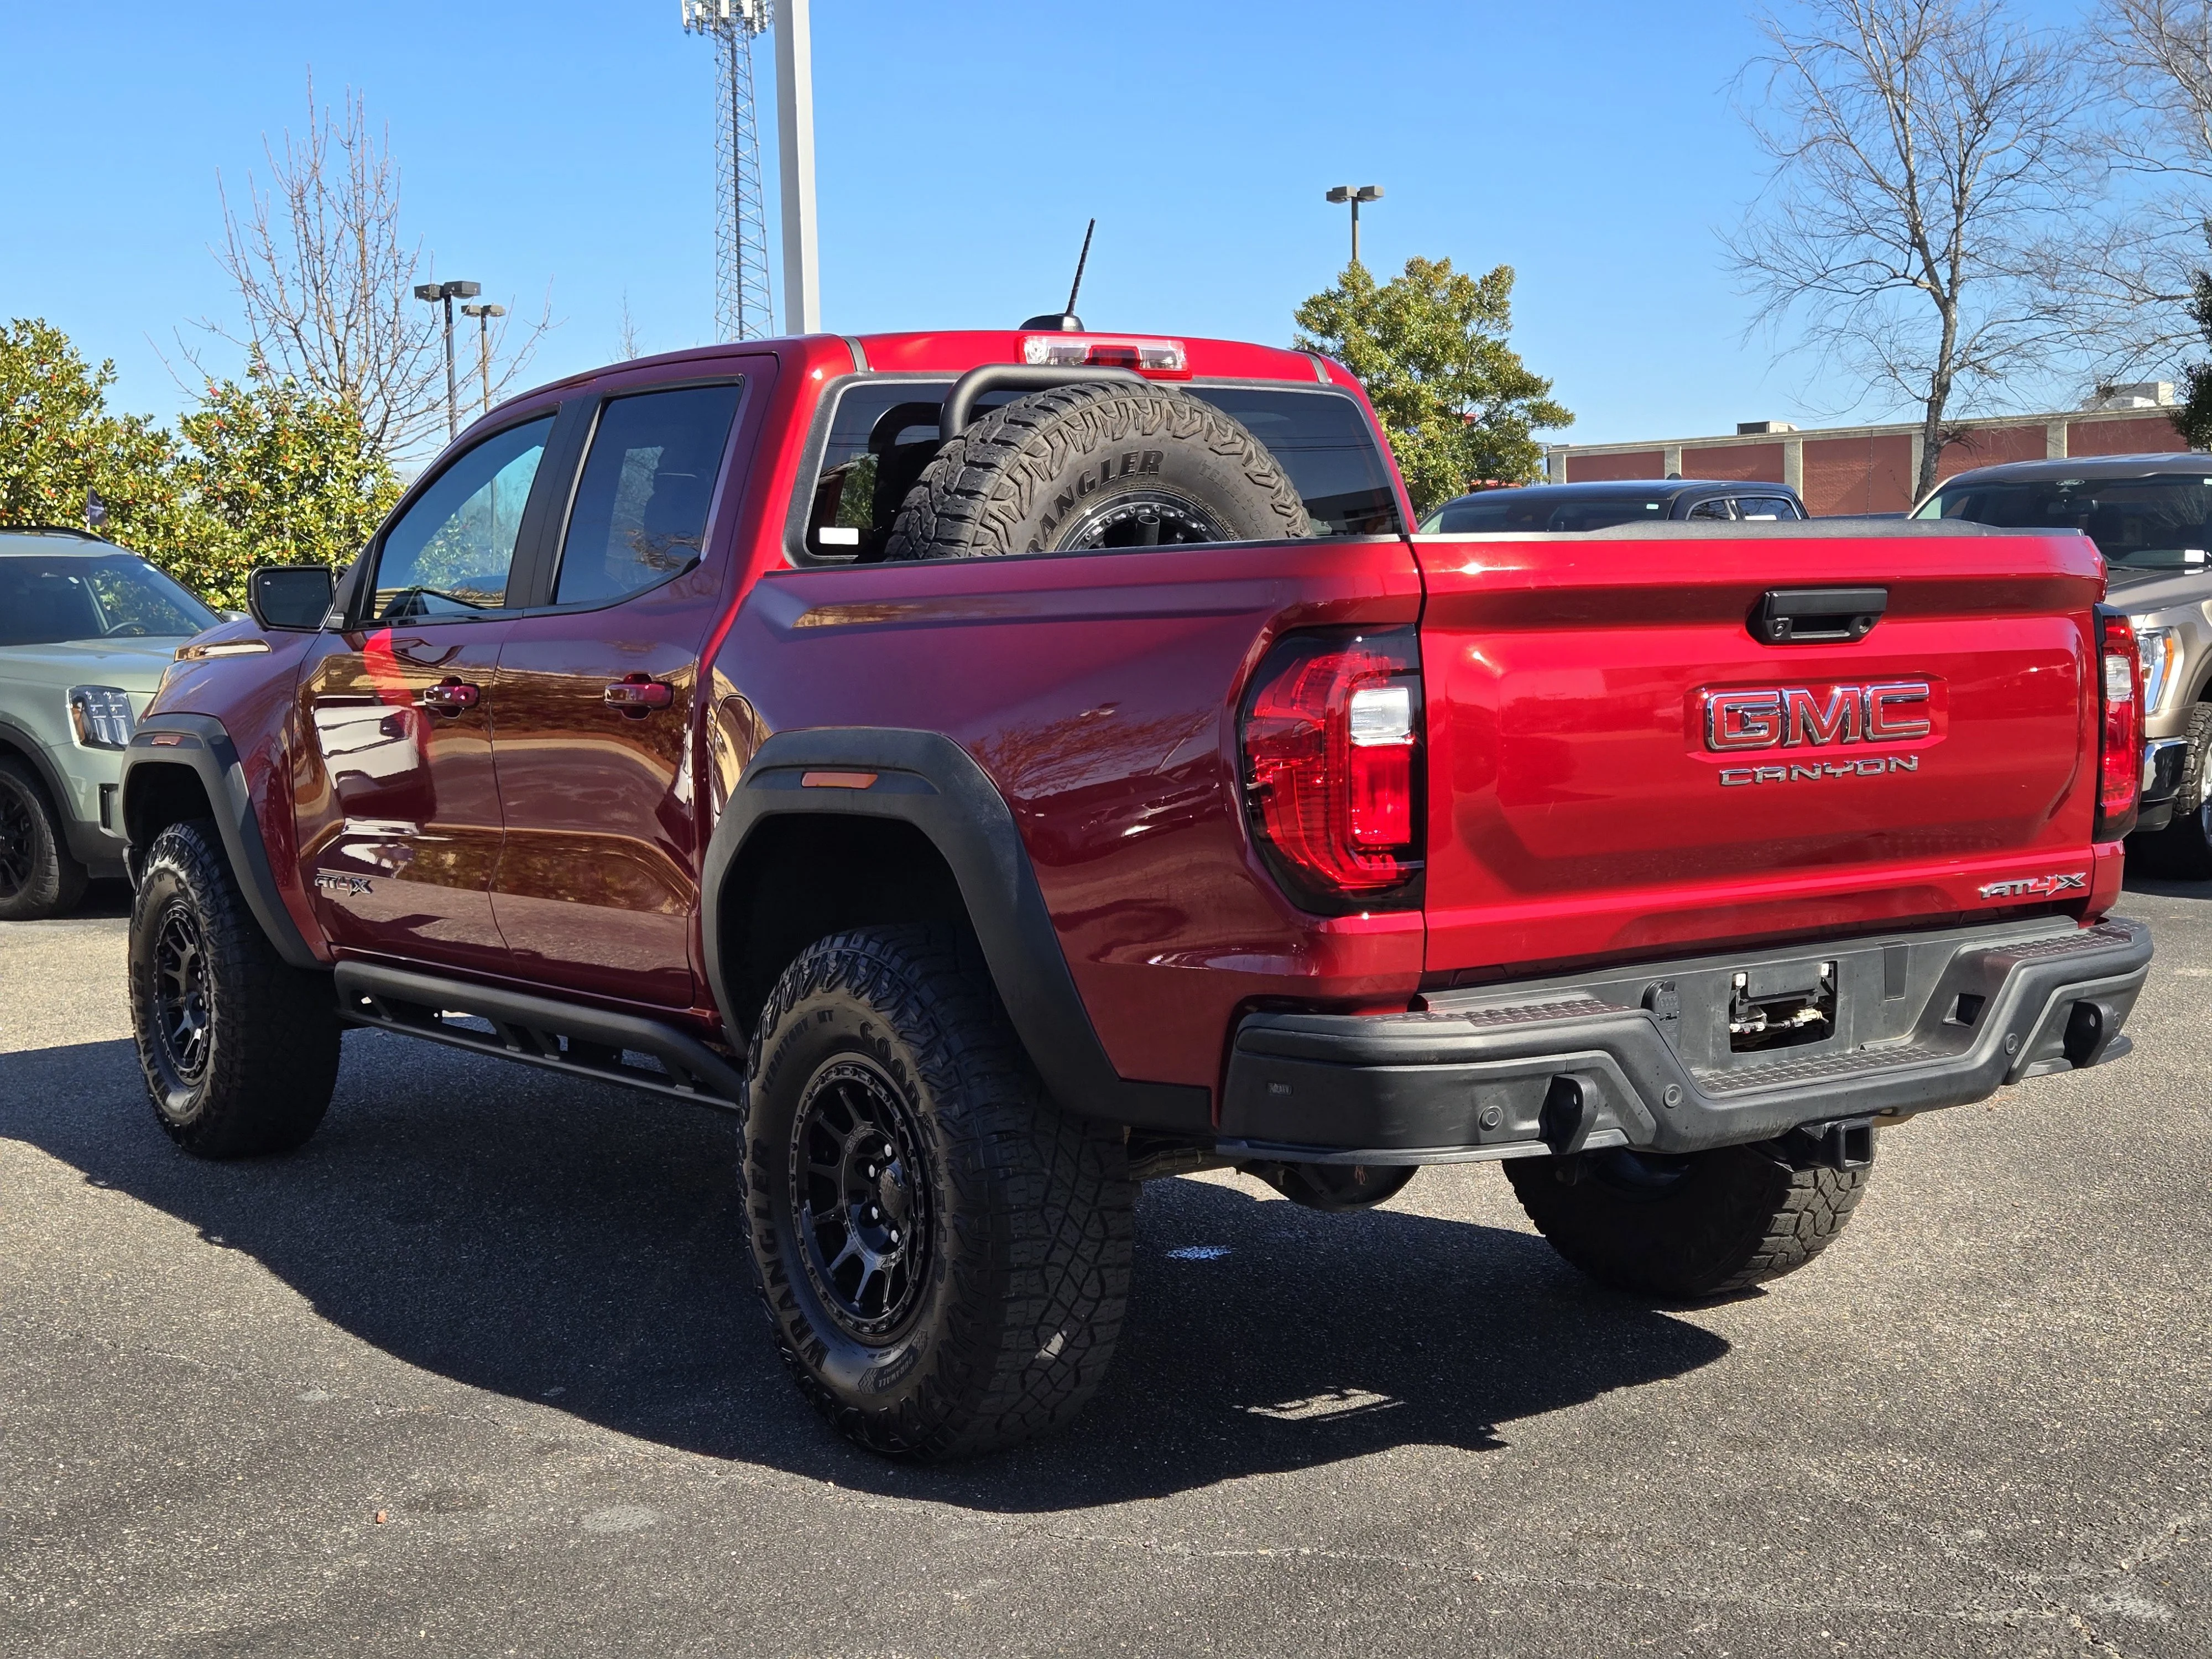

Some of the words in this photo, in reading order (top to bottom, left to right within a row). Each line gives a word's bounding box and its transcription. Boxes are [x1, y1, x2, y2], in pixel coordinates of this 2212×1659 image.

[1705, 682, 1931, 750] GMC
[1719, 755, 1919, 786] CANYON
[314, 874, 373, 896] AT4X
[1978, 872, 2086, 898] AT4X
[761, 1016, 809, 1094] TERRITORY
[844, 1125, 868, 1154] GMC
[753, 1138, 830, 1372] WRANGLER
[878, 1354, 914, 1388] DURAWALL
